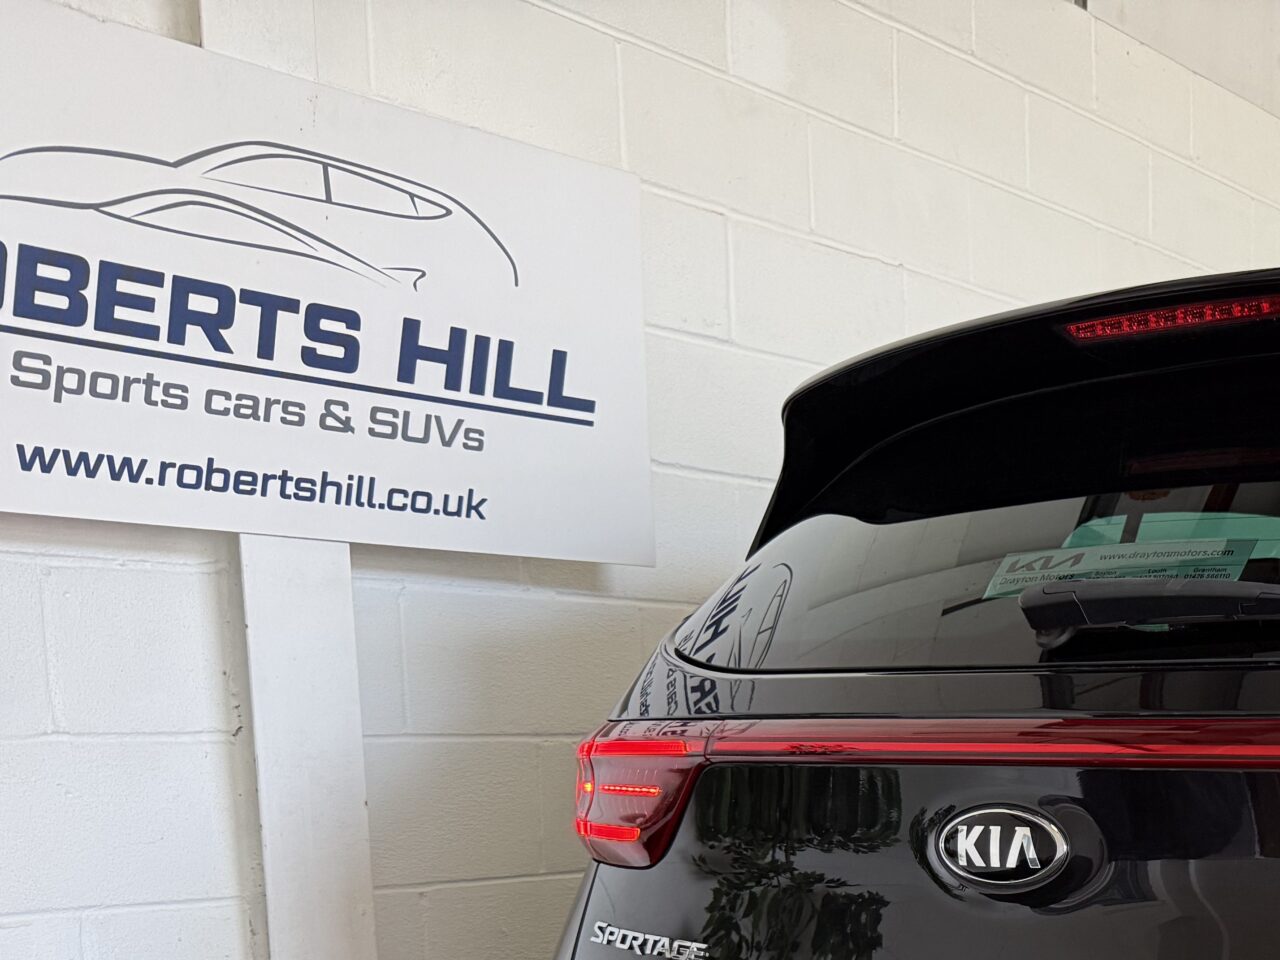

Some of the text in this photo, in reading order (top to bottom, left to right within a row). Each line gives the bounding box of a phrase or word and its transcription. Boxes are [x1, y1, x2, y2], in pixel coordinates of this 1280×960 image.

[0, 241, 596, 414] BERTS HILL
[10, 349, 485, 453] Sports cars & SUVs
[16, 442, 488, 522] www.robertshill.co.uk
[1099, 548, 1235, 561] www.draytonmotors.com
[1193, 566, 1228, 574] Grantham
[999, 575, 1039, 586] Drayton
[1040, 572, 1076, 582] Motors
[957, 825, 1042, 869] KIA
